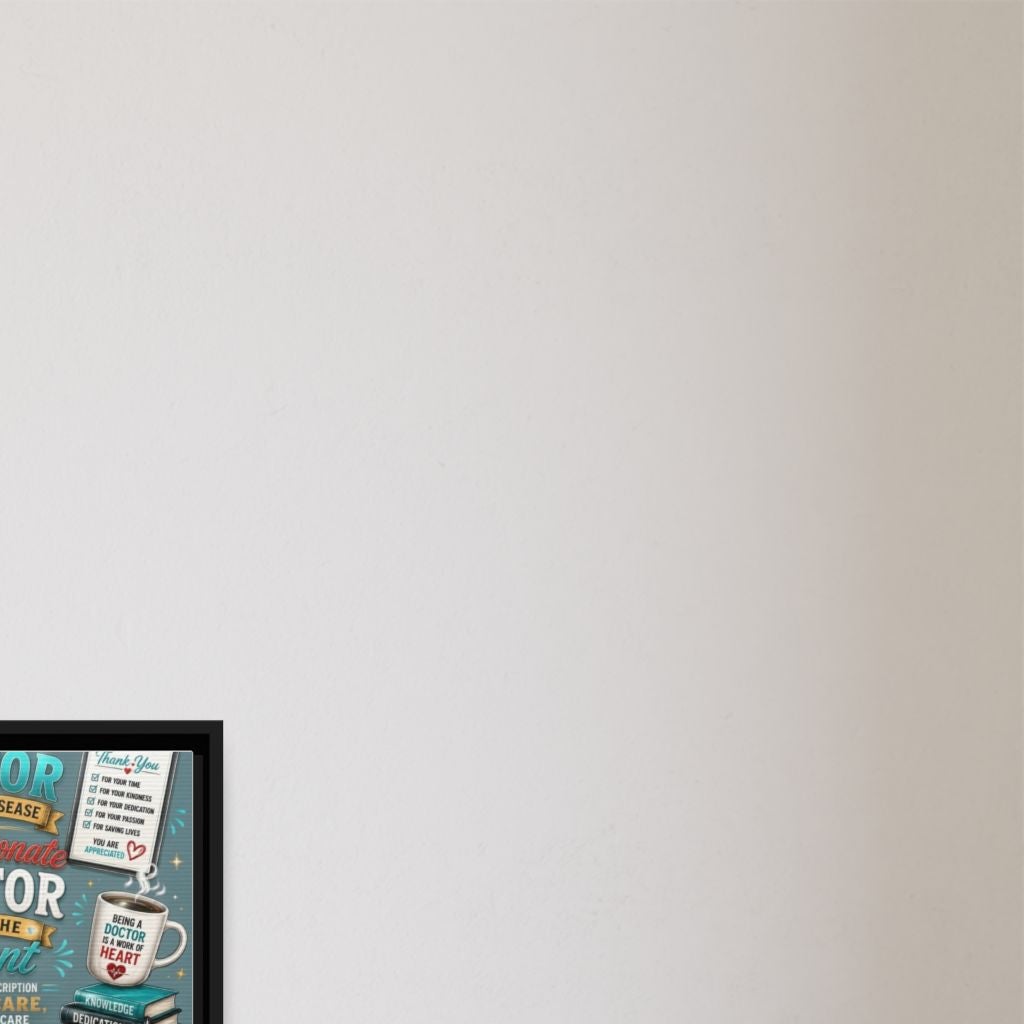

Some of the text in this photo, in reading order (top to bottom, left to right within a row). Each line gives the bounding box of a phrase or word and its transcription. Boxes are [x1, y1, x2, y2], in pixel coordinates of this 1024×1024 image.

[95, 751, 160, 774] Thank You
[101, 775, 141, 788] FOR YOUR TIME
[99, 787, 152, 802] FOR YOUR KINDNESS
[97, 799, 155, 814] FOR YOUR DEDICATION
[95, 810, 145, 825] FOR YOUR PASSION
[93, 823, 141, 837] FOR SAVING LIVES
[93, 838, 119, 849] YOU ARE
[84, 846, 125, 860] APPRECIATED
[112, 914, 142, 929] BEING A
[104, 923, 146, 943] DOCTOR
[102, 936, 144, 952] IS A WORK OF
[100, 946, 141, 966] HEART
[84, 996, 134, 1016] KNOWLEDGE
[0, 1015, 30, 1024] CARE
